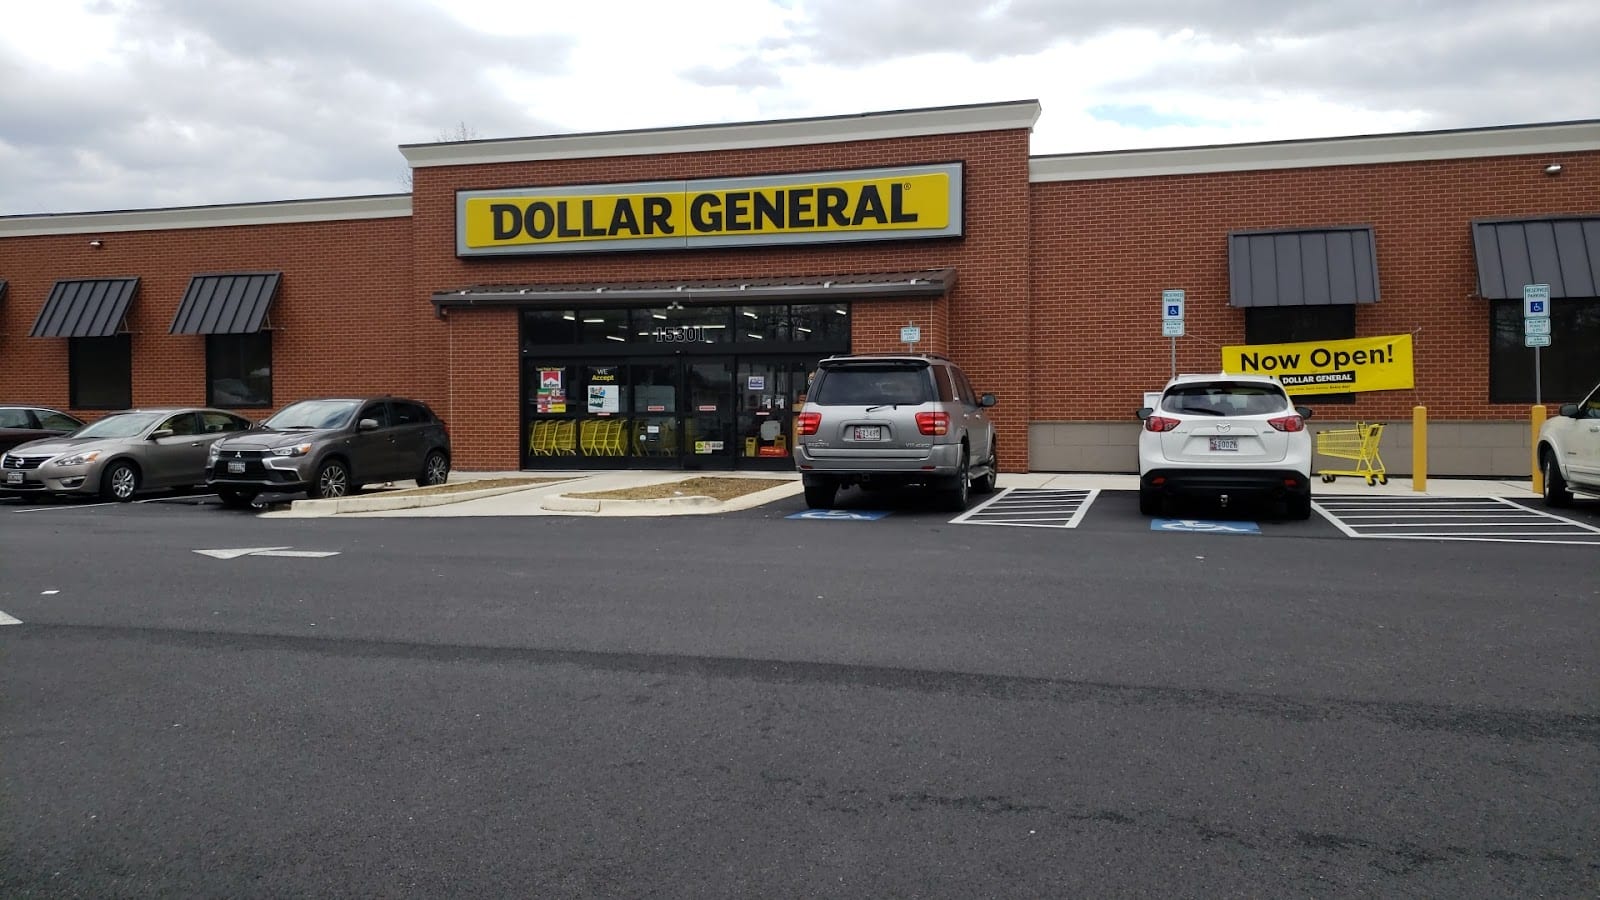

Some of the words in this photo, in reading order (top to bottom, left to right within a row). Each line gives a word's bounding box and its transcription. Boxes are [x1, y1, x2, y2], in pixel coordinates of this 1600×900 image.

[490, 197, 674, 240] DOLLAR
[689, 182, 919, 233] GENERAL
[656, 326, 705, 343] 15301
[1241, 352, 1301, 372] Now
[1310, 344, 1393, 371] Open!
[591, 374, 615, 382] Accept
[1282, 375, 1314, 384] DOLLAR
[1315, 373, 1352, 383] GENERAL
